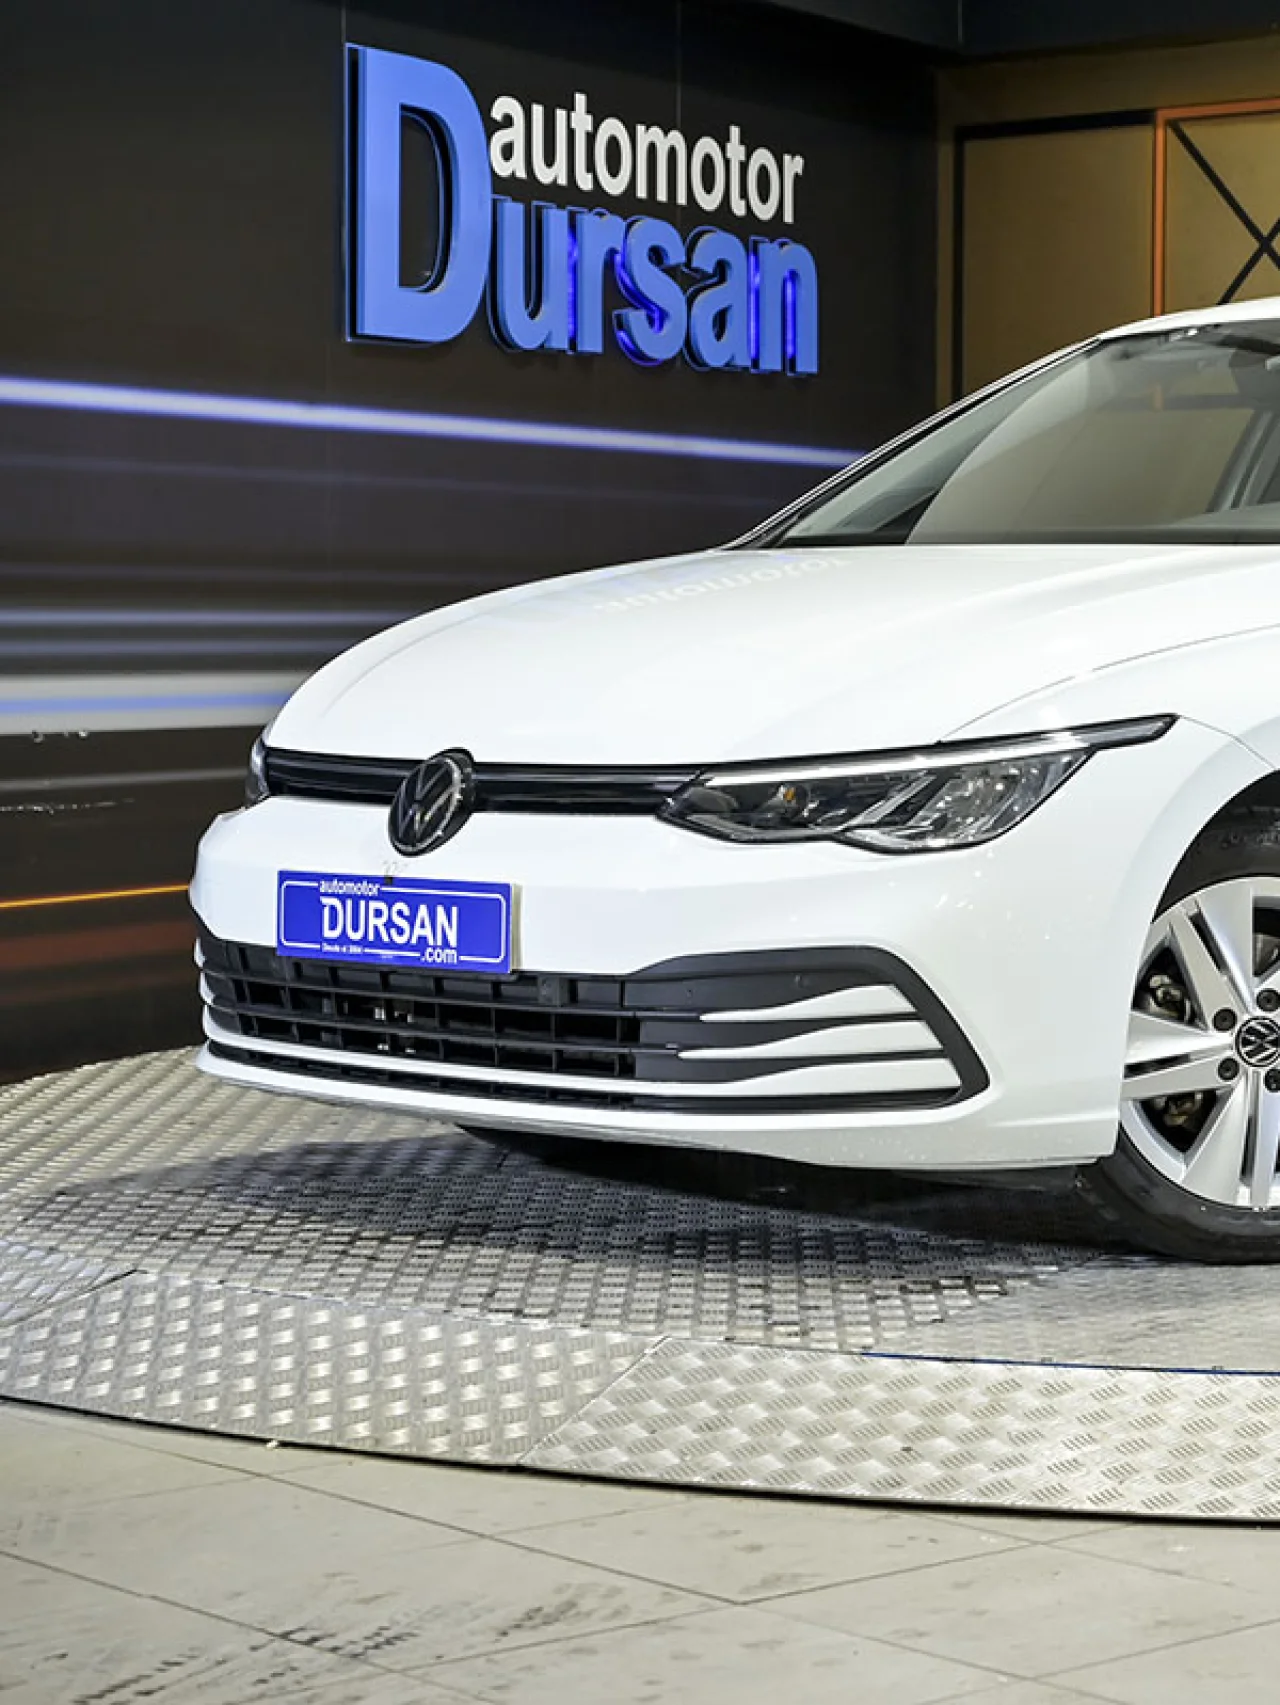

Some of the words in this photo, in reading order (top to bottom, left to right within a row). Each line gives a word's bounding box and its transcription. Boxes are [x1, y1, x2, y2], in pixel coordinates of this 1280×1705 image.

[490, 92, 804, 223] automotor
[345, 43, 818, 375] Dursan
[320, 879, 380, 896] automotor
[320, 896, 458, 948] DURSAN
[421, 948, 458, 964] .com
